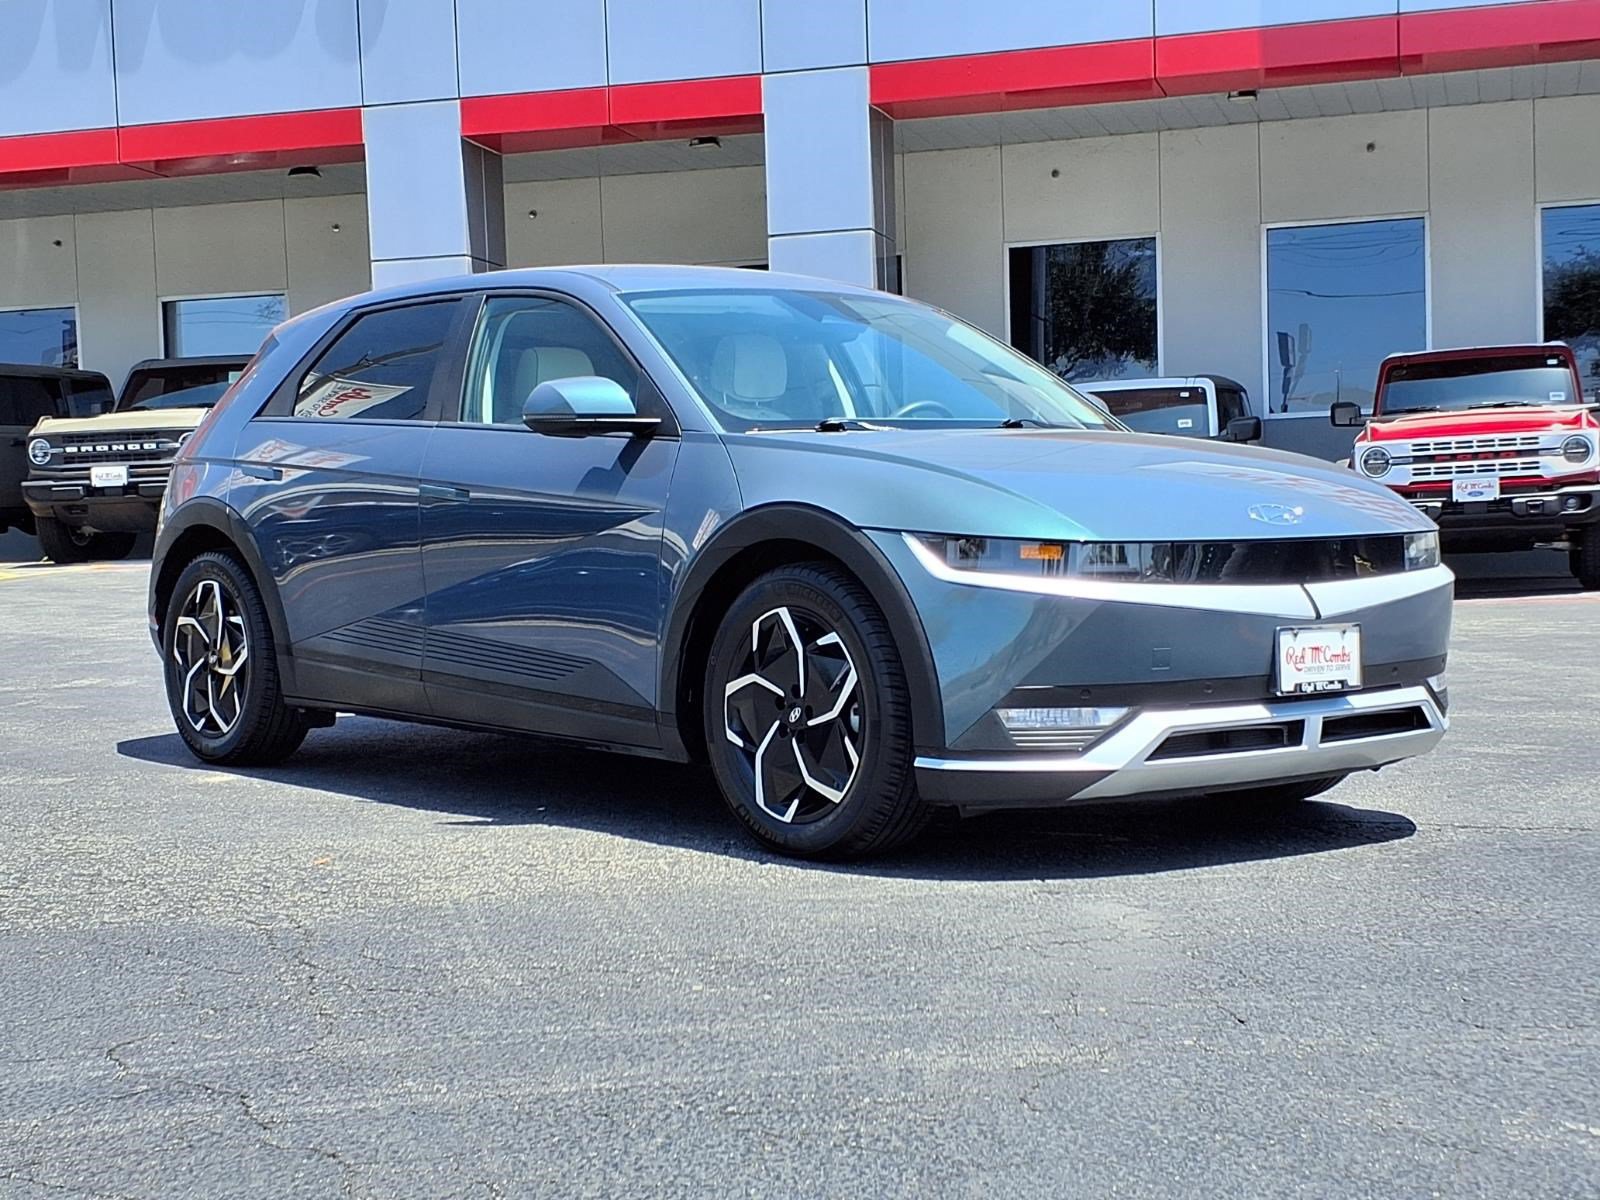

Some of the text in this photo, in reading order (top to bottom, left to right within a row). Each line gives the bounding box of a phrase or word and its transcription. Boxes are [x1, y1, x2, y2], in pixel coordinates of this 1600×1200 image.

[65, 443, 157, 453] BRONCO
[1435, 452, 1518, 463] FORD
[1286, 646, 1305, 672] Red
[1304, 665, 1325, 673] DRIVEN
[1326, 664, 1334, 672] TO
